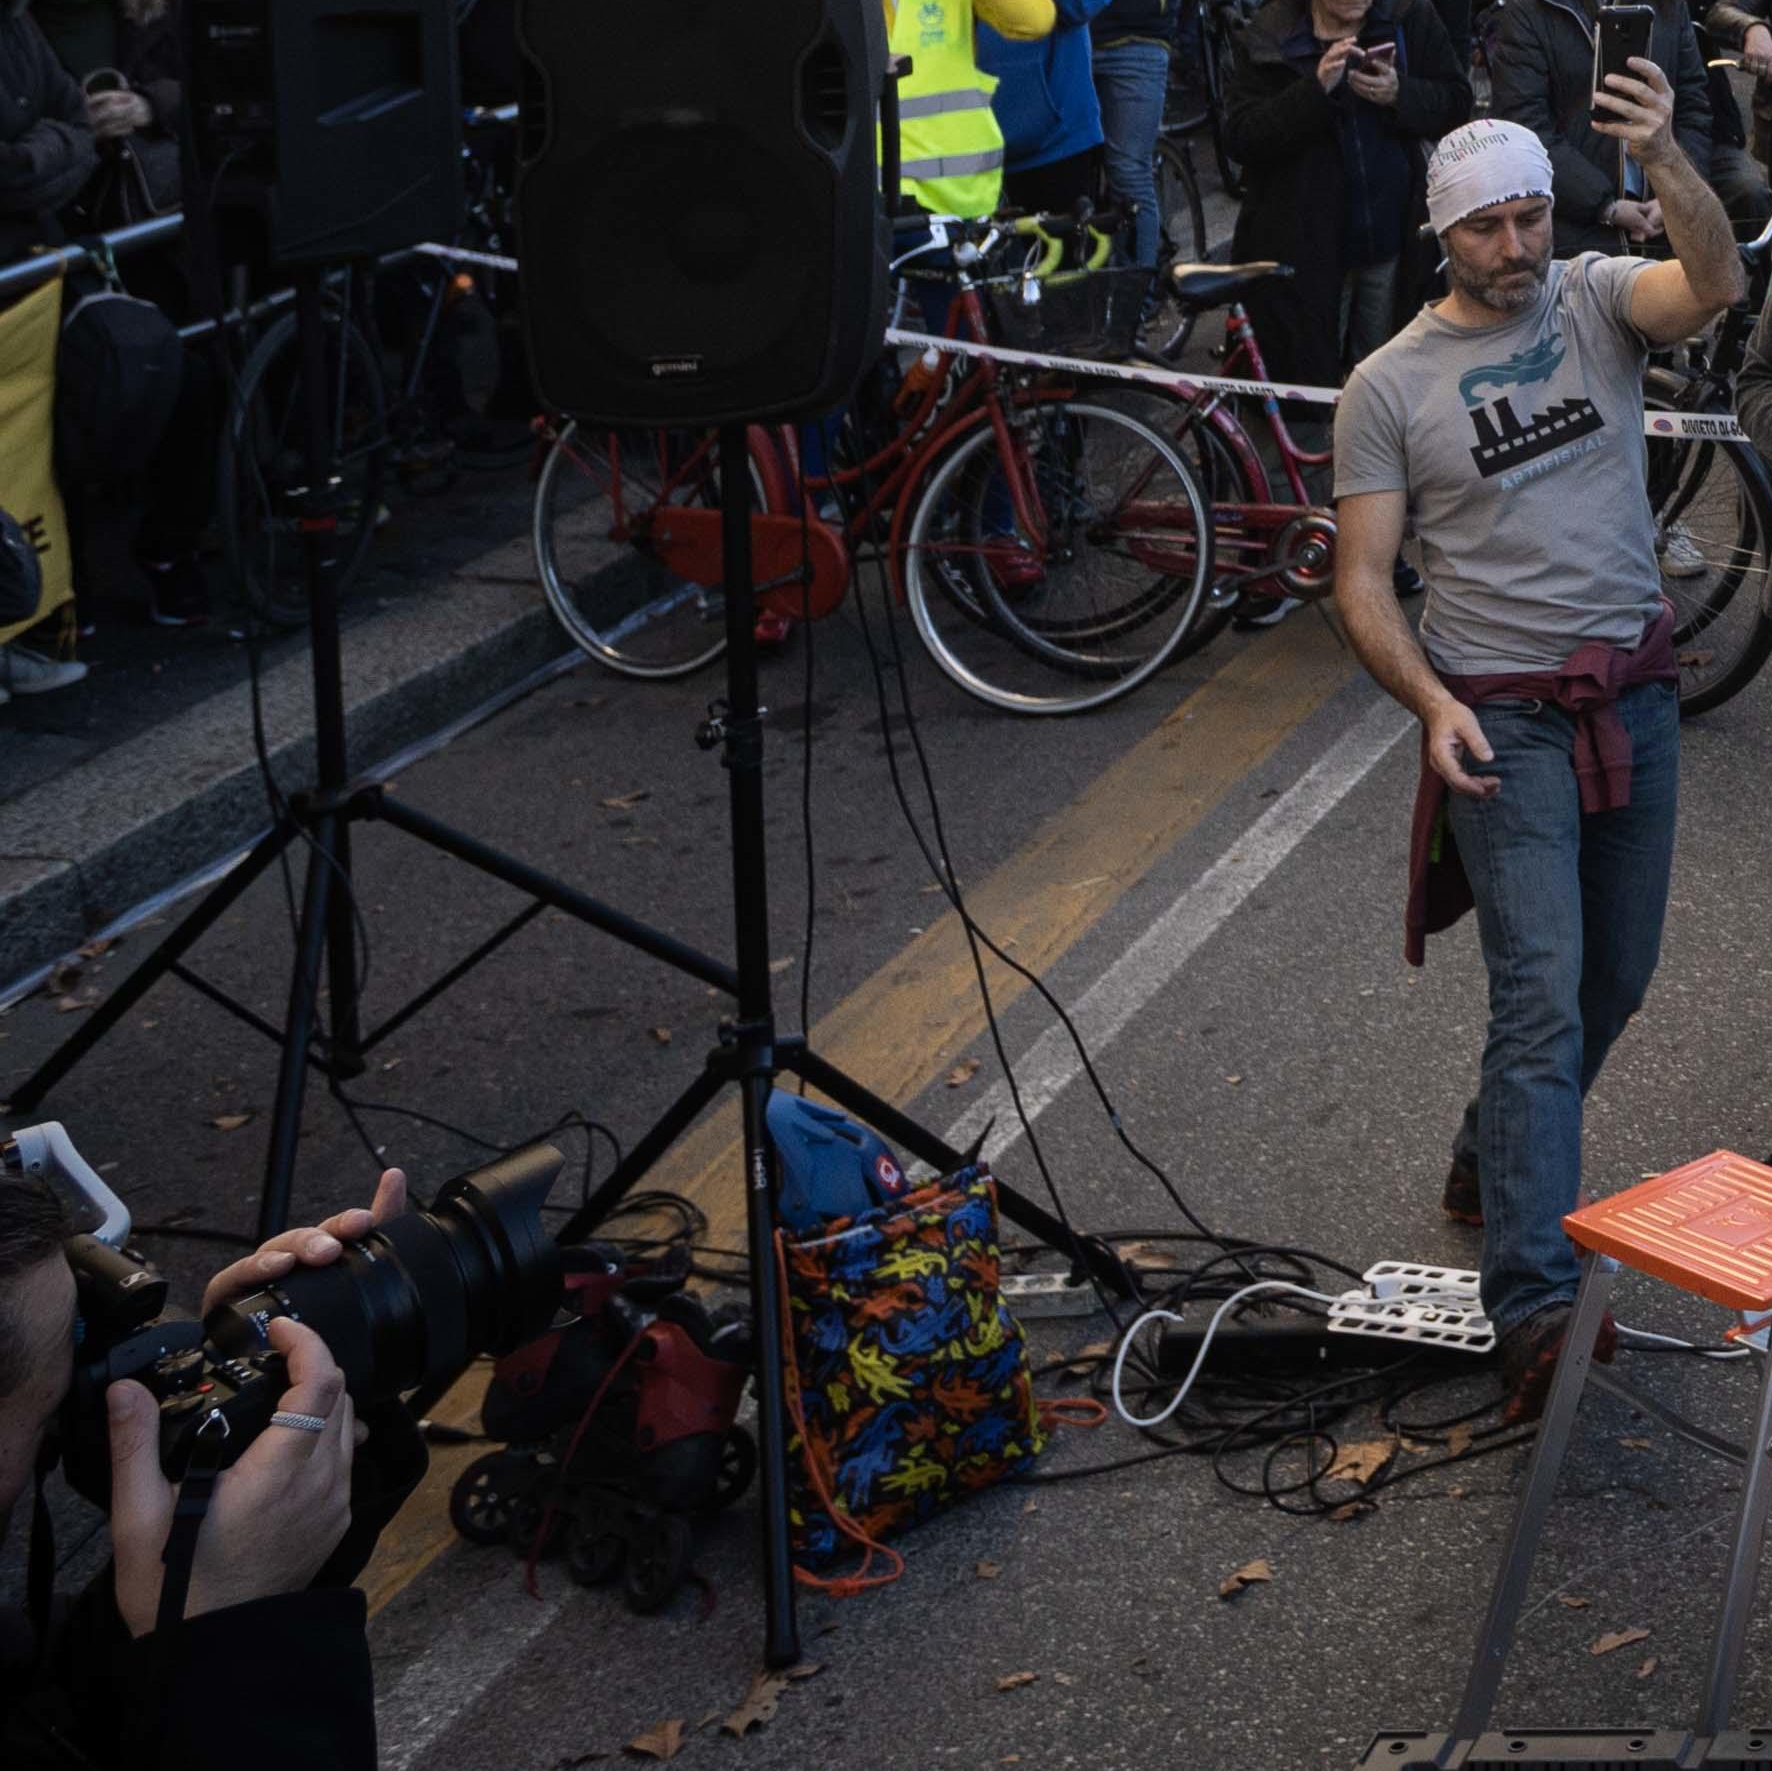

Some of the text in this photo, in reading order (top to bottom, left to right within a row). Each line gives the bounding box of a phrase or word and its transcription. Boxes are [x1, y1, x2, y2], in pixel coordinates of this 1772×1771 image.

[652, 359, 698, 377] gemini
[1682, 419, 1715, 436] DIVIETO
[1500, 434, 1607, 492] ARTIFISHAL
